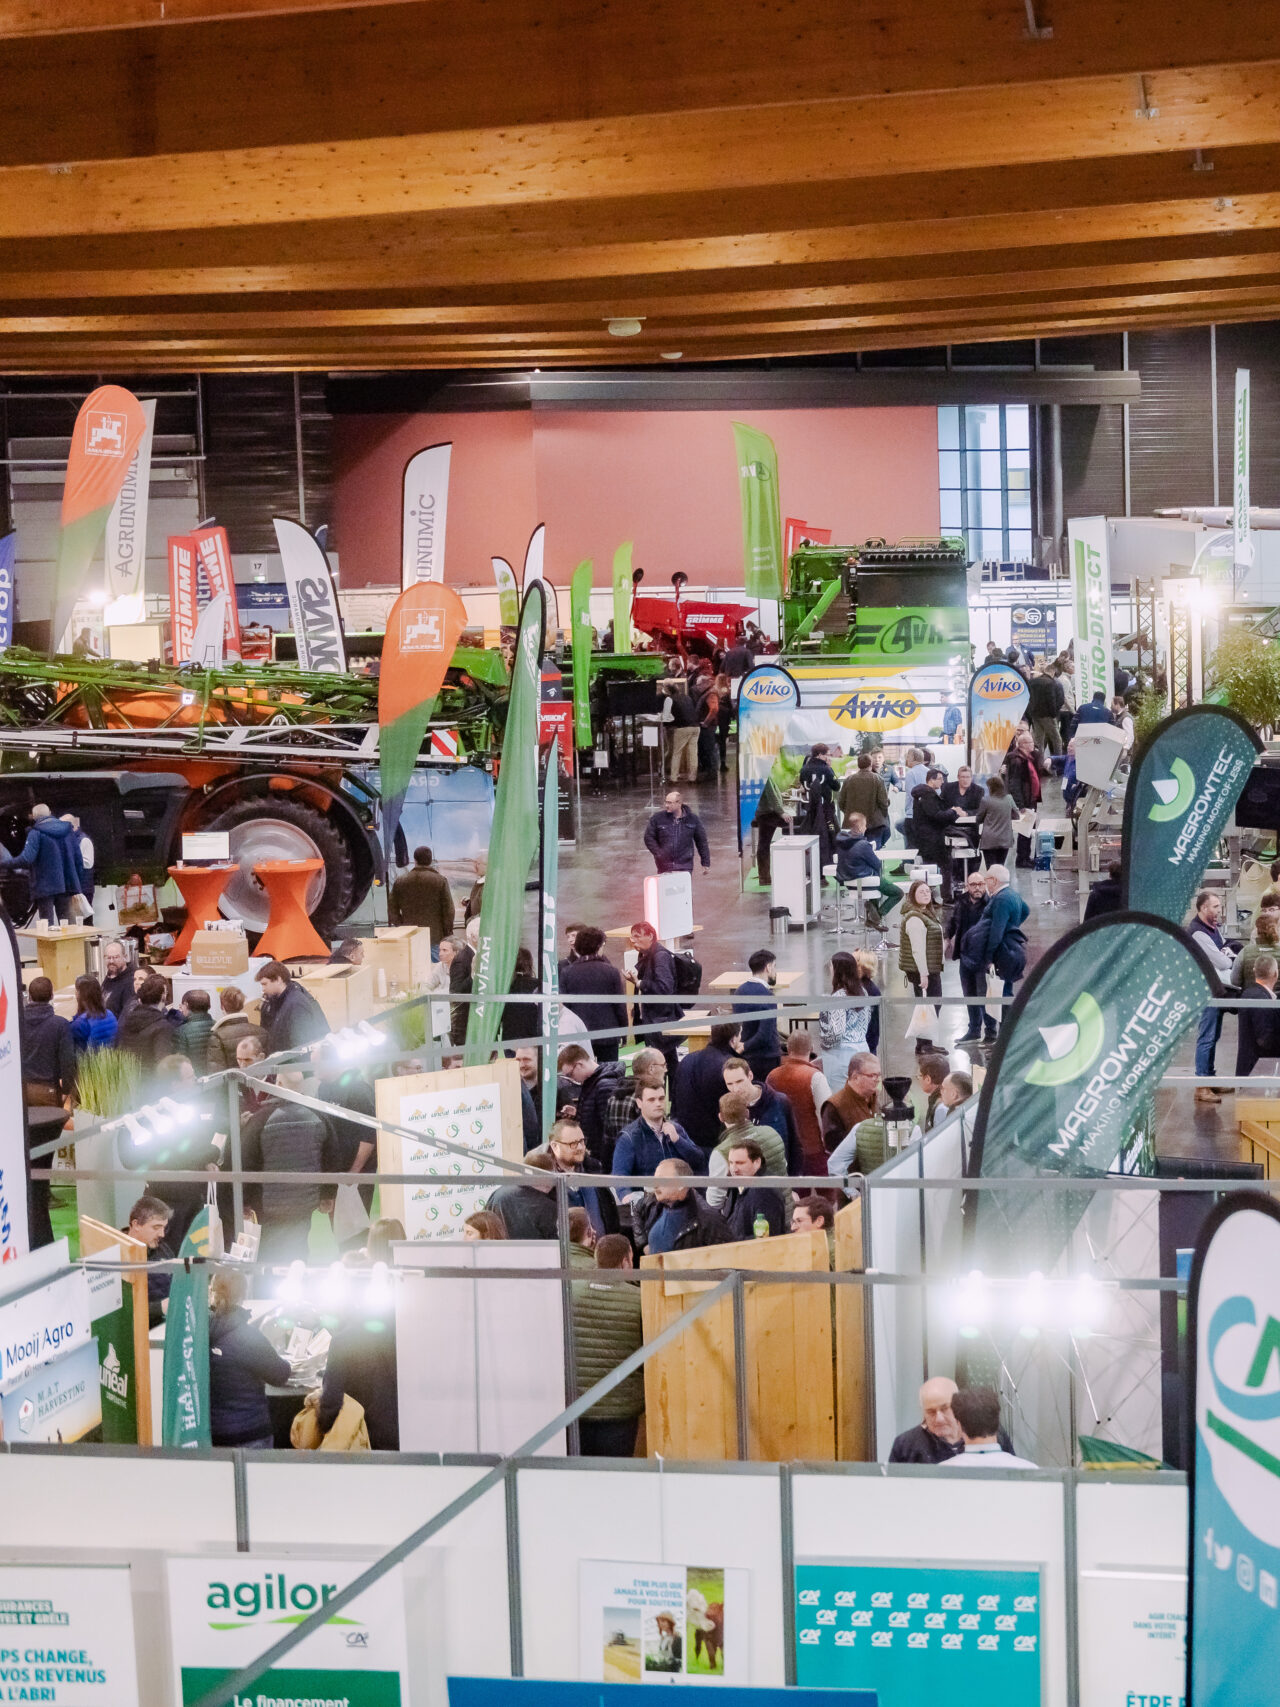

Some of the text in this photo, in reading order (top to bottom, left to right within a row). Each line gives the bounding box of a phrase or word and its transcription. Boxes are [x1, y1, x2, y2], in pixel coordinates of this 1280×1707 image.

[410, 493, 436, 584] ONOMIC
[253, 562, 263, 571] 17
[685, 614, 724, 624] GRIMME
[1168, 748, 1234, 866] MAGROWTEC
[1186, 759, 1244, 864] MAKING MORE OF LESS
[1047, 980, 1172, 1157] MAGROWTEC
[1078, 1099, 1122, 1156] MAKING
[1120, 1053, 1150, 1099] MORE
[1146, 1034, 1163, 1058] OF
[1158, 1000, 1188, 1039] LESS
[6, 1320, 75, 1369] Mooij Agro
[206, 1572, 339, 1617] agilor
[0, 1649, 93, 1666] PS CHANGE,
[0, 1668, 106, 1684] VOS REVENUS
[9, 1687, 56, 1701] L'ABRI
